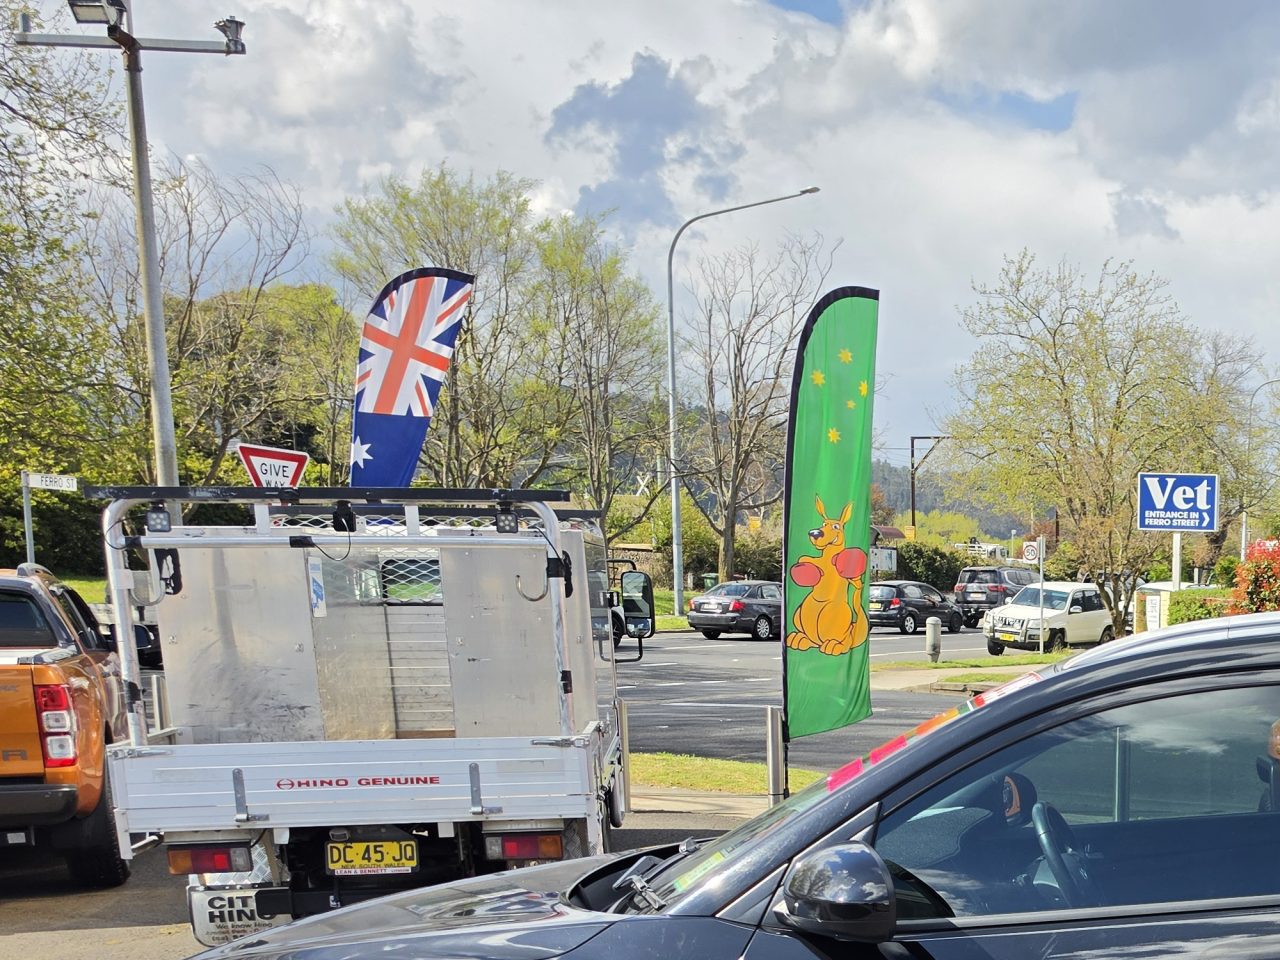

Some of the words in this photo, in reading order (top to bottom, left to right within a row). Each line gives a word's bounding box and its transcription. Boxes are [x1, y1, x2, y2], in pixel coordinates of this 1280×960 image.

[260, 462, 289, 478] GIVE
[40, 475, 63, 488] FERRO
[66, 477, 74, 489] ST
[1143, 477, 1211, 510] Vet
[297, 778, 349, 788] HINO
[357, 776, 440, 787] GENUINE
[208, 896, 253, 909] CIT
